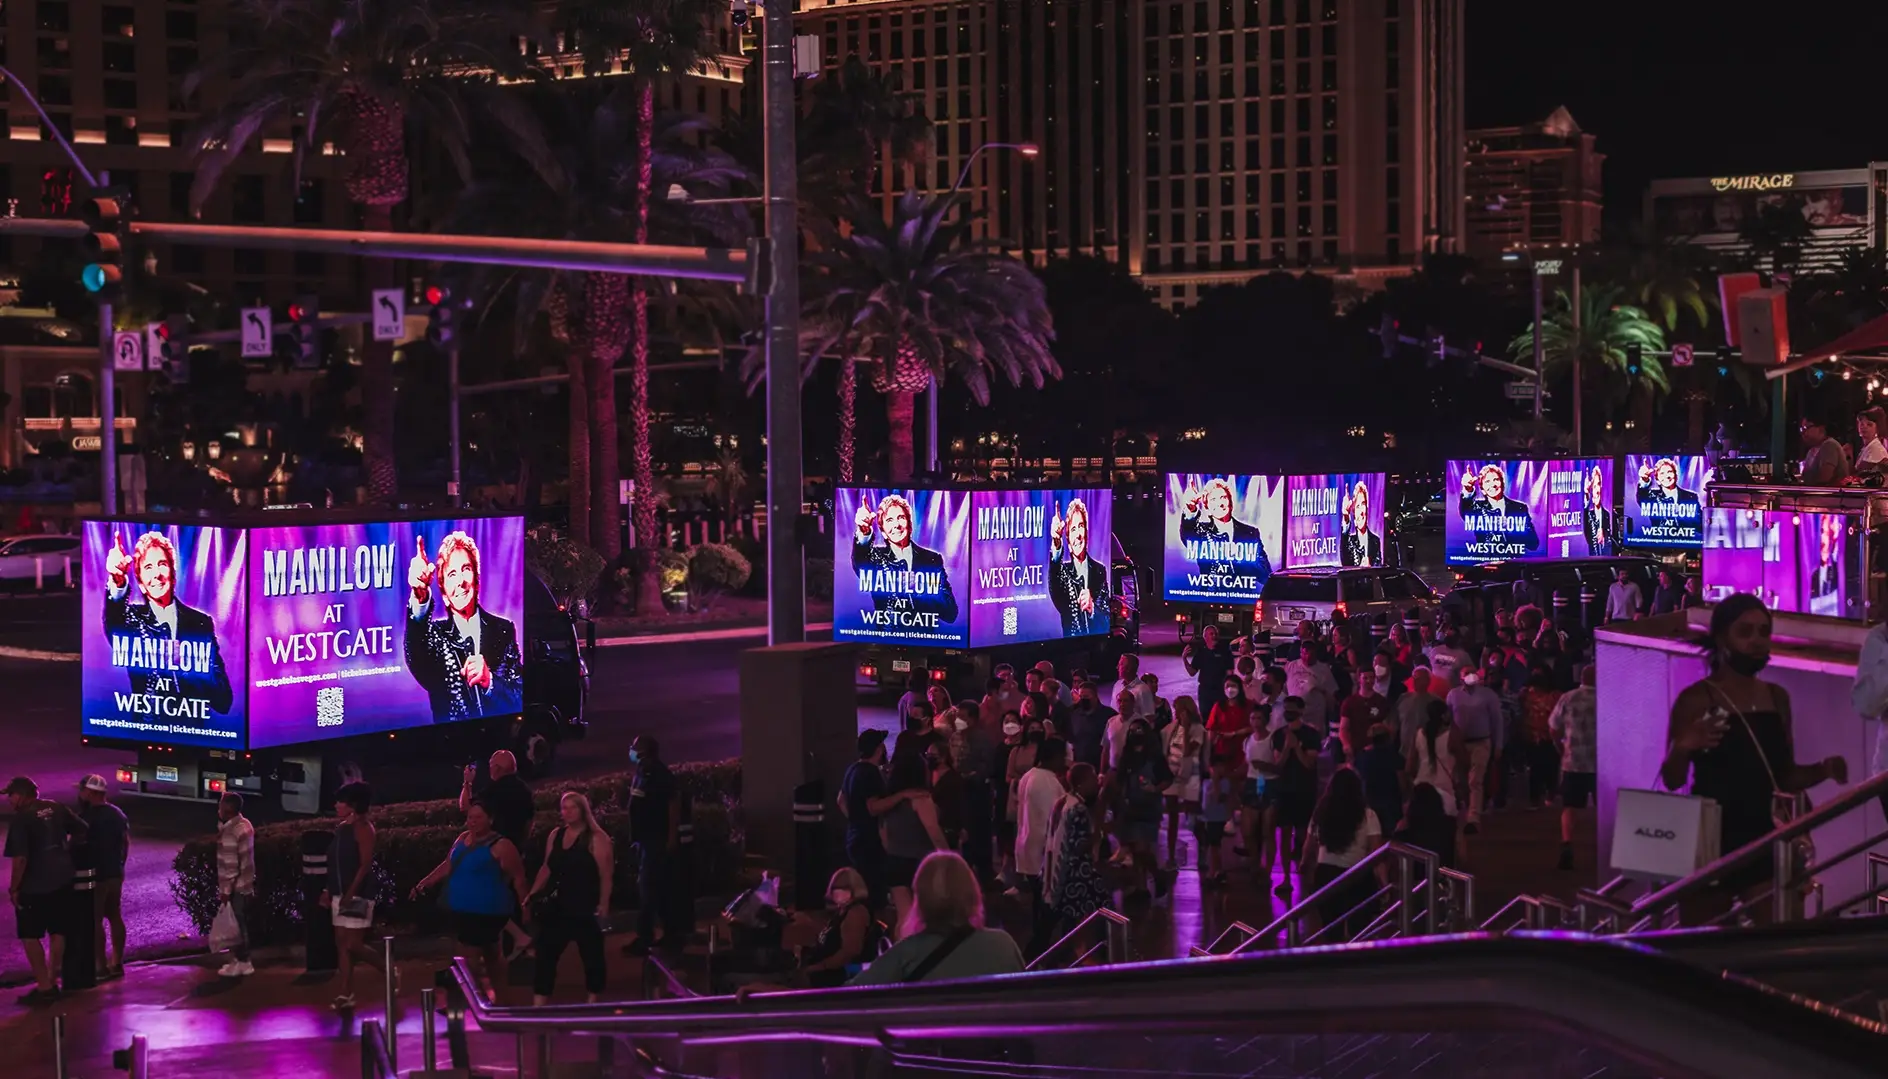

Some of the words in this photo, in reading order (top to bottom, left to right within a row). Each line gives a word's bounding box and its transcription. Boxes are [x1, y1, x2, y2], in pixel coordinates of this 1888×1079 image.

[1711, 178, 1729, 186] THE
[1716, 174, 1793, 191] MIRAGE
[378, 325, 399, 335] ONLY
[246, 343, 267, 352] ONLY
[1551, 471, 1582, 494] MANILOW
[1292, 488, 1338, 517] MANILOW
[1641, 502, 1697, 517] MANILOW
[978, 505, 1044, 541] MANILOW
[1464, 515, 1527, 532] MANILOW
[1551, 511, 1581, 527] WESTGATE
[1312, 523, 1320, 534] AT
[1641, 526, 1696, 537] WESTGATE
[1007, 548, 1018, 561] AT
[1186, 540, 1258, 562] MANILOW
[1292, 537, 1337, 557] WESTGATE
[1465, 542, 1526, 554] WESTGATE
[264, 543, 395, 597] MANILOW
[979, 565, 1042, 588] WESTGATE
[1217, 565, 1229, 573] AT
[859, 568, 940, 594] MANILOW
[1187, 573, 1257, 589] WESTGATE
[894, 599, 908, 609] AT
[322, 604, 344, 624] AT
[860, 609, 939, 627] WESTGATE
[840, 629, 905, 637] westgatelasvegas.com
[909, 632, 961, 640] ticketmaster.com
[112, 635, 211, 673] MANILOW
[266, 626, 393, 665] WESTGATE
[155, 678, 172, 691] AT
[256, 671, 337, 688] westgatelasvegas.com
[341, 665, 401, 678] ticketmaster.com
[114, 692, 211, 719] WESTGATE
[89, 718, 169, 732] westgatelasvegas.com
[173, 726, 238, 739] ticketmaster.com
[1634, 828, 1676, 841] ALDO
